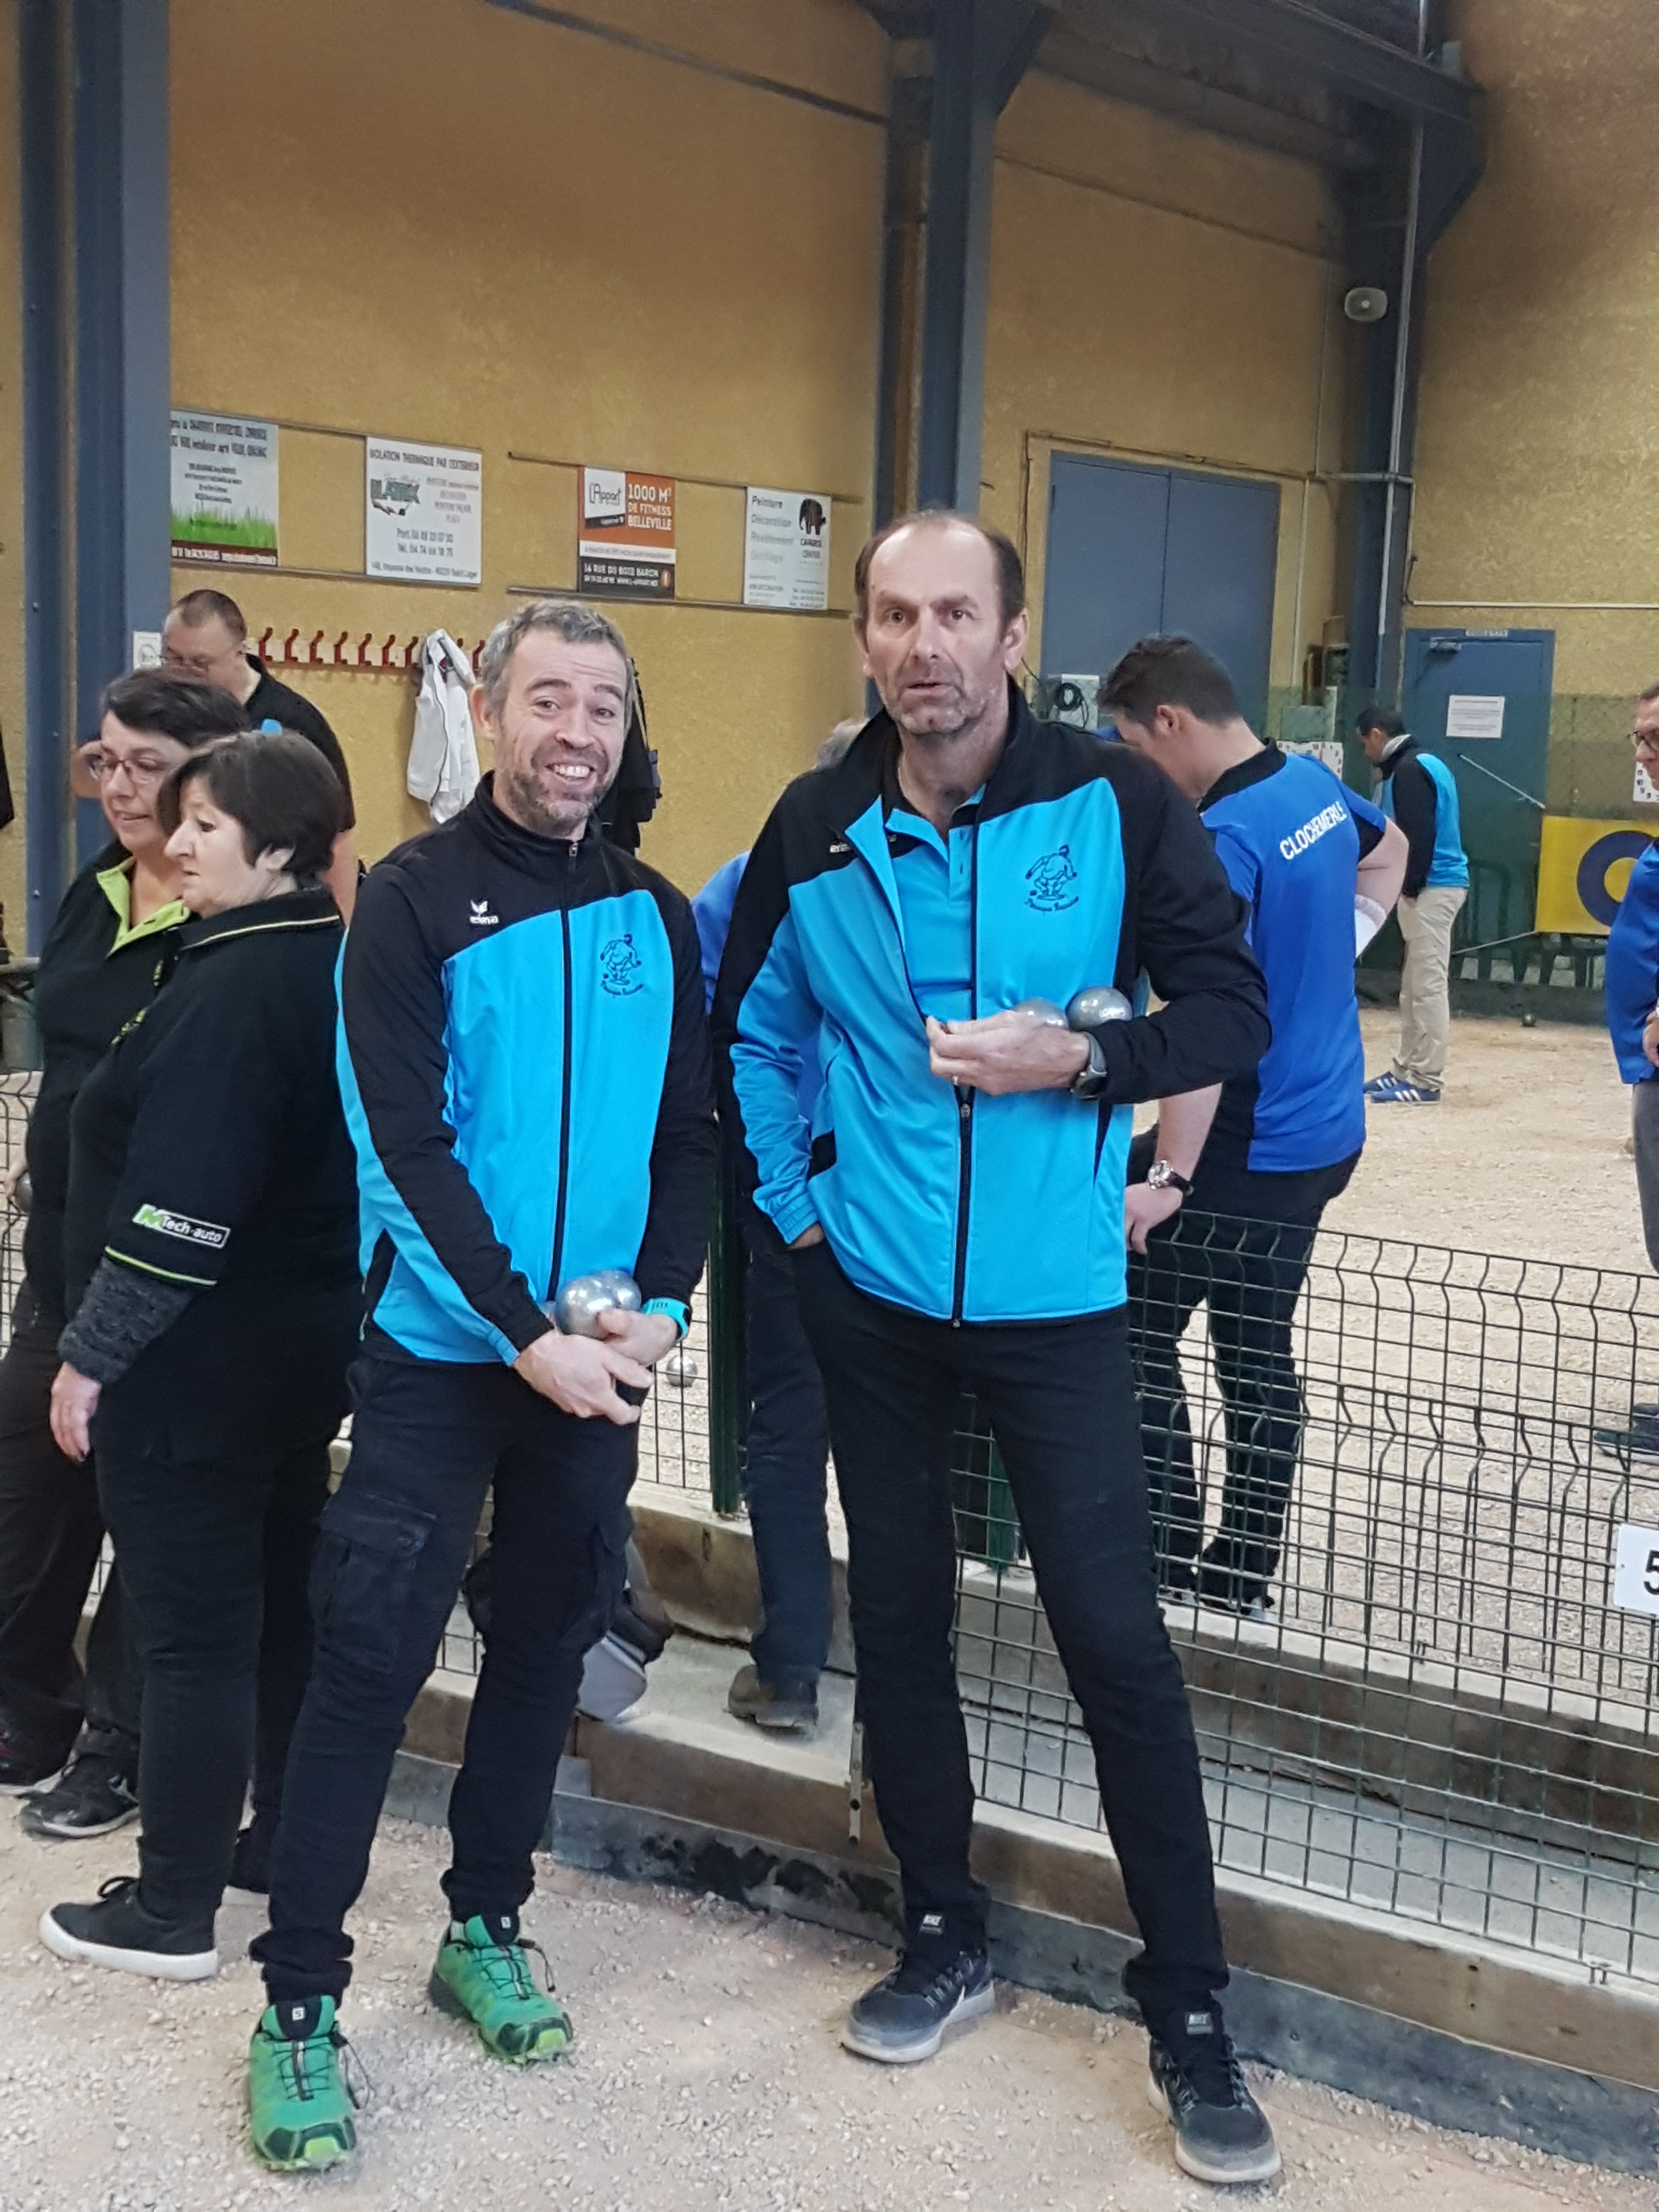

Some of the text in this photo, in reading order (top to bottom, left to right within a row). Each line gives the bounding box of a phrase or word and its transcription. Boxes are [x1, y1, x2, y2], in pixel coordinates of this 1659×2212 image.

[628, 483, 656, 501] 1000
[628, 501, 672, 516] DE FITNESS
[752, 495, 783, 509] Peinture
[628, 515, 672, 531] BELLEVILLE
